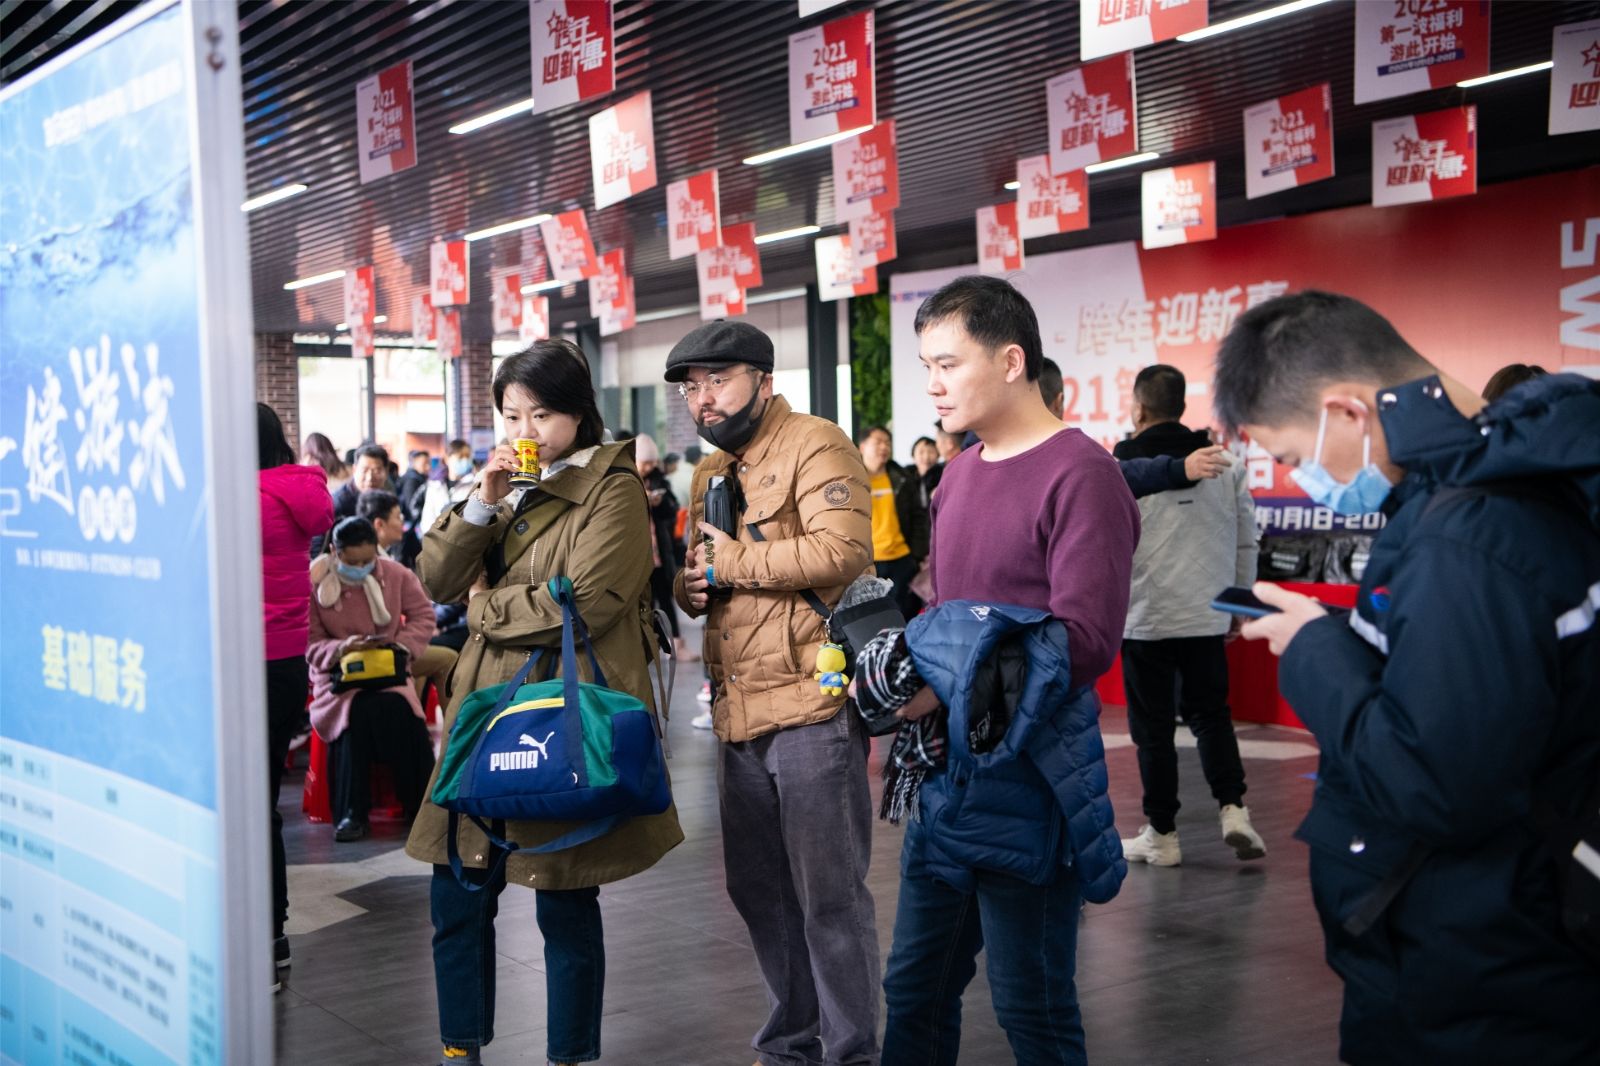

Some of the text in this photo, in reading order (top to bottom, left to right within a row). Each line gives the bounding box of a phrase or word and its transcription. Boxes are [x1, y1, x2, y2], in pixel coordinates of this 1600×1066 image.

[1097, 0, 1190, 27] 迎新
[813, 40, 848, 67] 2021
[1269, 109, 1305, 134] 2021
[1254, 504, 1387, 531] 年1月1日-20
[41, 624, 147, 714] 基础服务
[490, 750, 538, 771] PUMA
